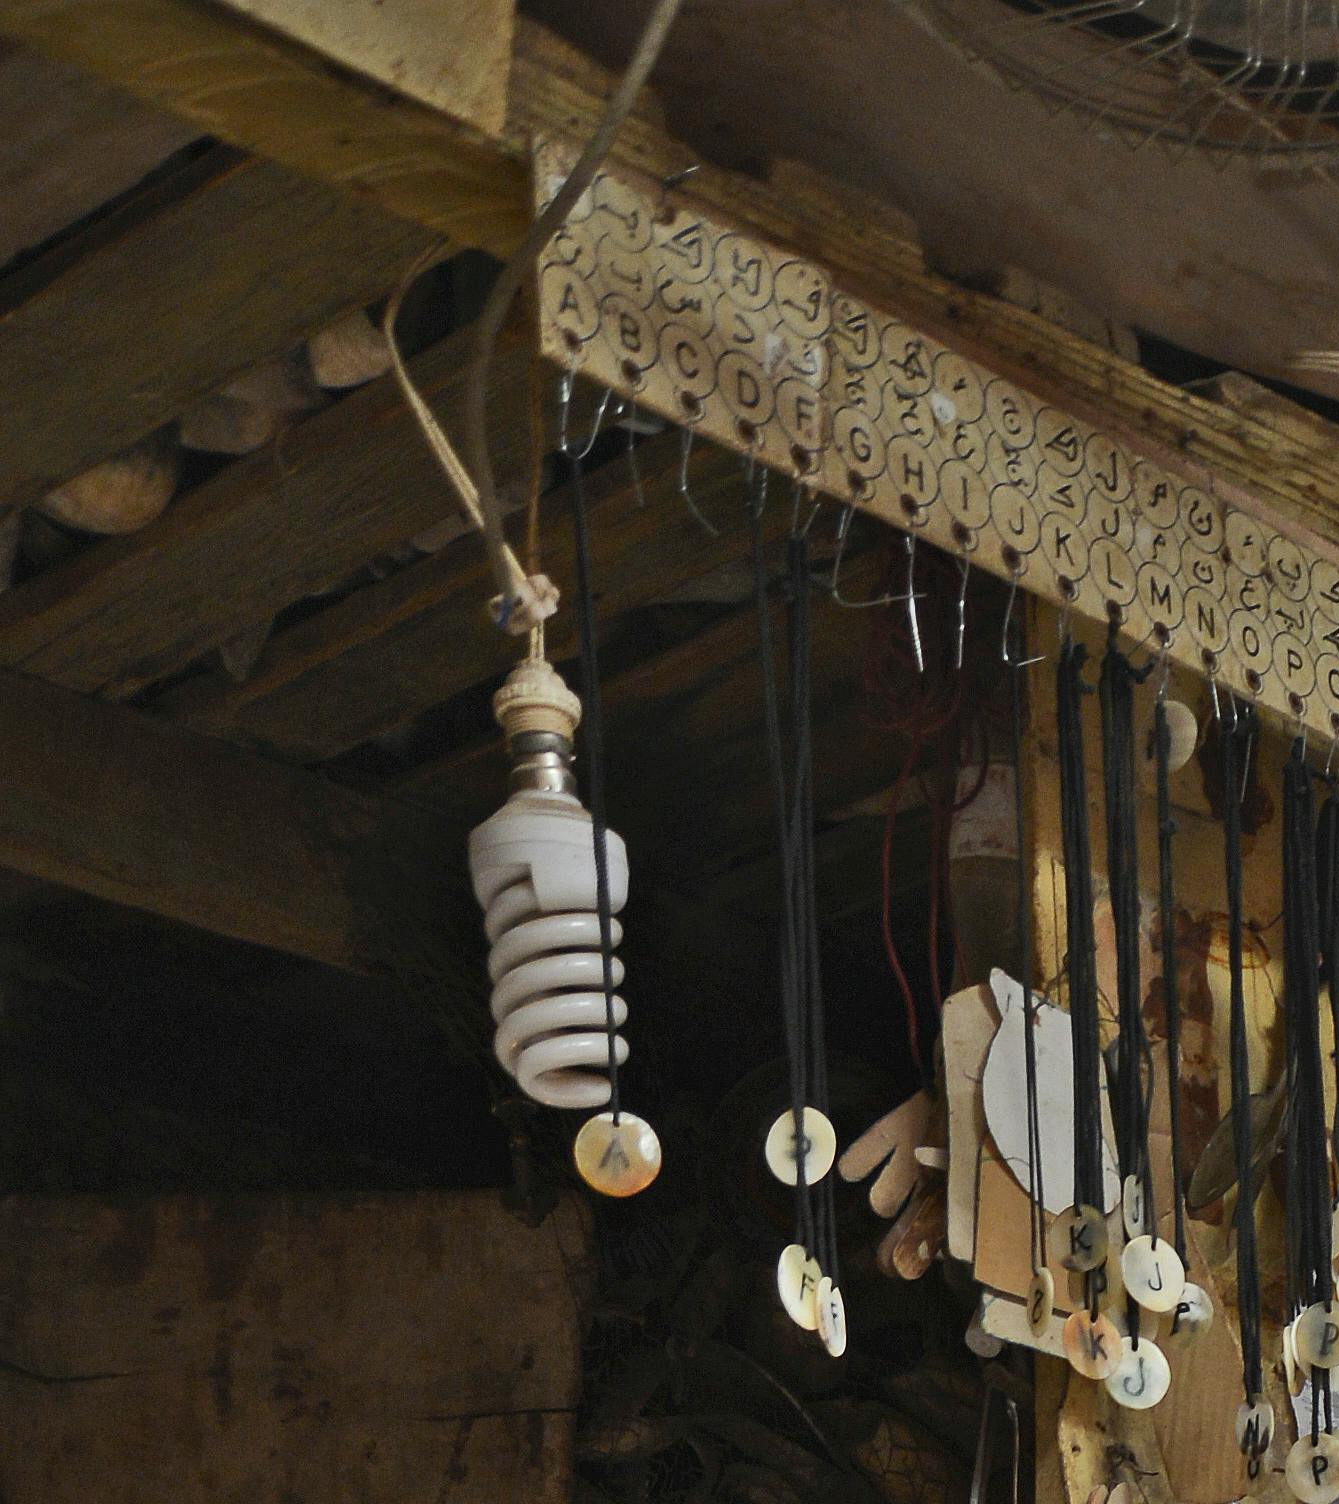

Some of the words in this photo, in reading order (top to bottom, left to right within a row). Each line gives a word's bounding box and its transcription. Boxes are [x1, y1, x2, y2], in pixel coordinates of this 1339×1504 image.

[619, 312, 642, 352] B
[675, 341, 699, 379] C
[737, 368, 761, 408] D
[850, 426, 872, 463] G
[903, 453, 925, 493] H
[1008, 506, 1025, 536] J
[1055, 526, 1075, 567] K
[1106, 551, 1124, 590] L
[1150, 576, 1172, 615] M
[1197, 600, 1215, 639] N
[1242, 625, 1260, 657] O
[1287, 649, 1303, 678] P
[1070, 1223, 1092, 1255] K
[1310, 1454, 1329, 1487] P
